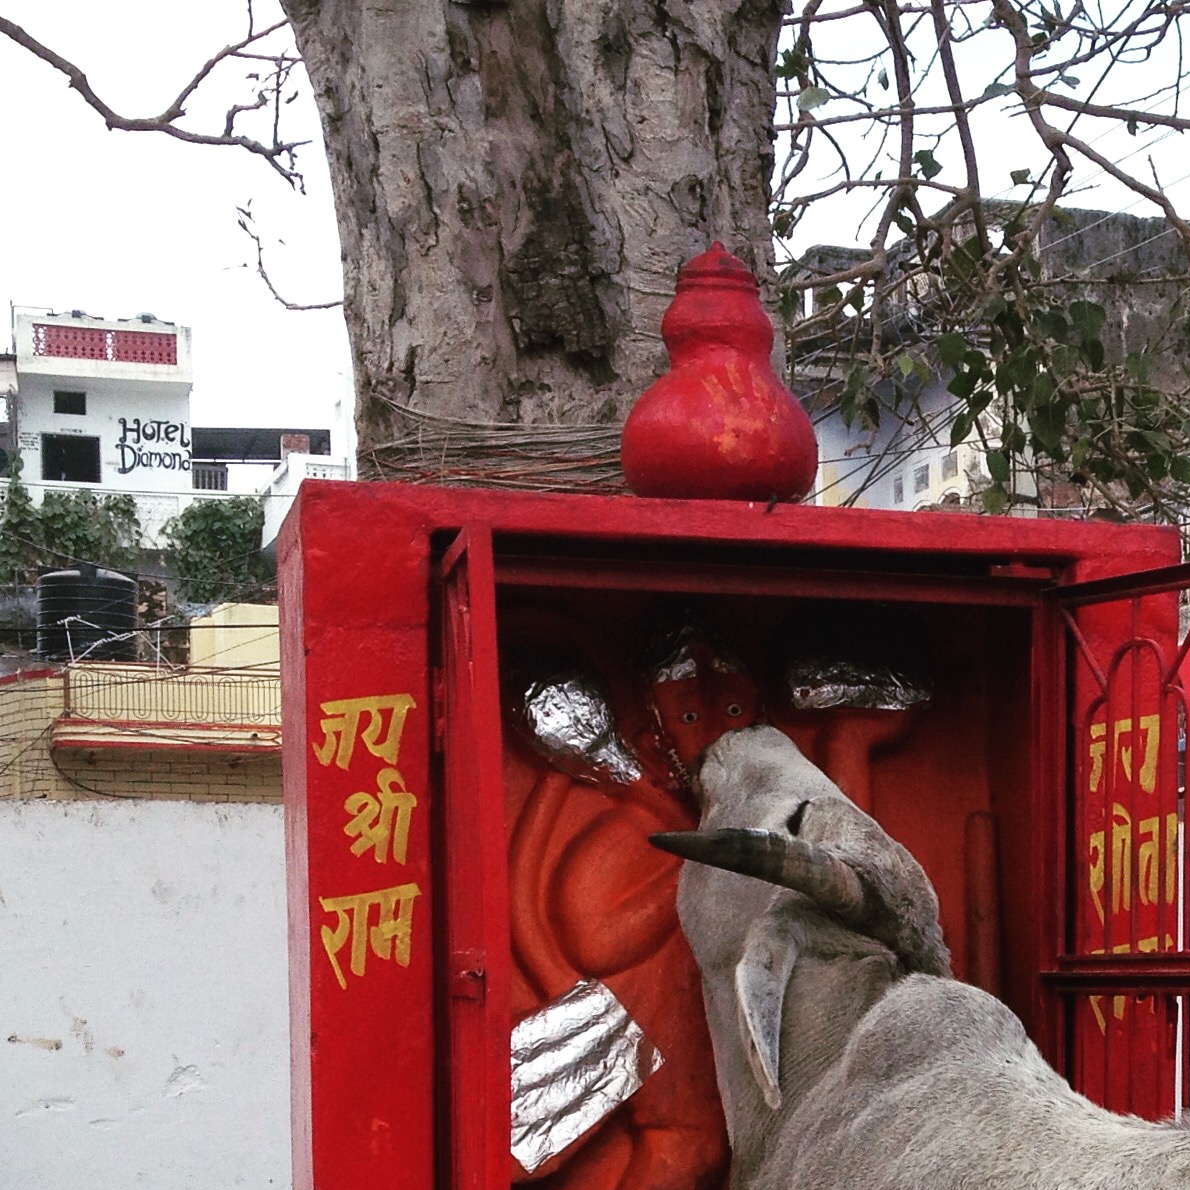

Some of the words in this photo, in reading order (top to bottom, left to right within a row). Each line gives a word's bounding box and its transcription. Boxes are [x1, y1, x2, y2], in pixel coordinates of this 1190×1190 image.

[115, 442, 193, 475] Diamond
[312, 693, 417, 771] जय
[343, 767, 418, 866] श्री
[318, 882, 422, 990] राम
